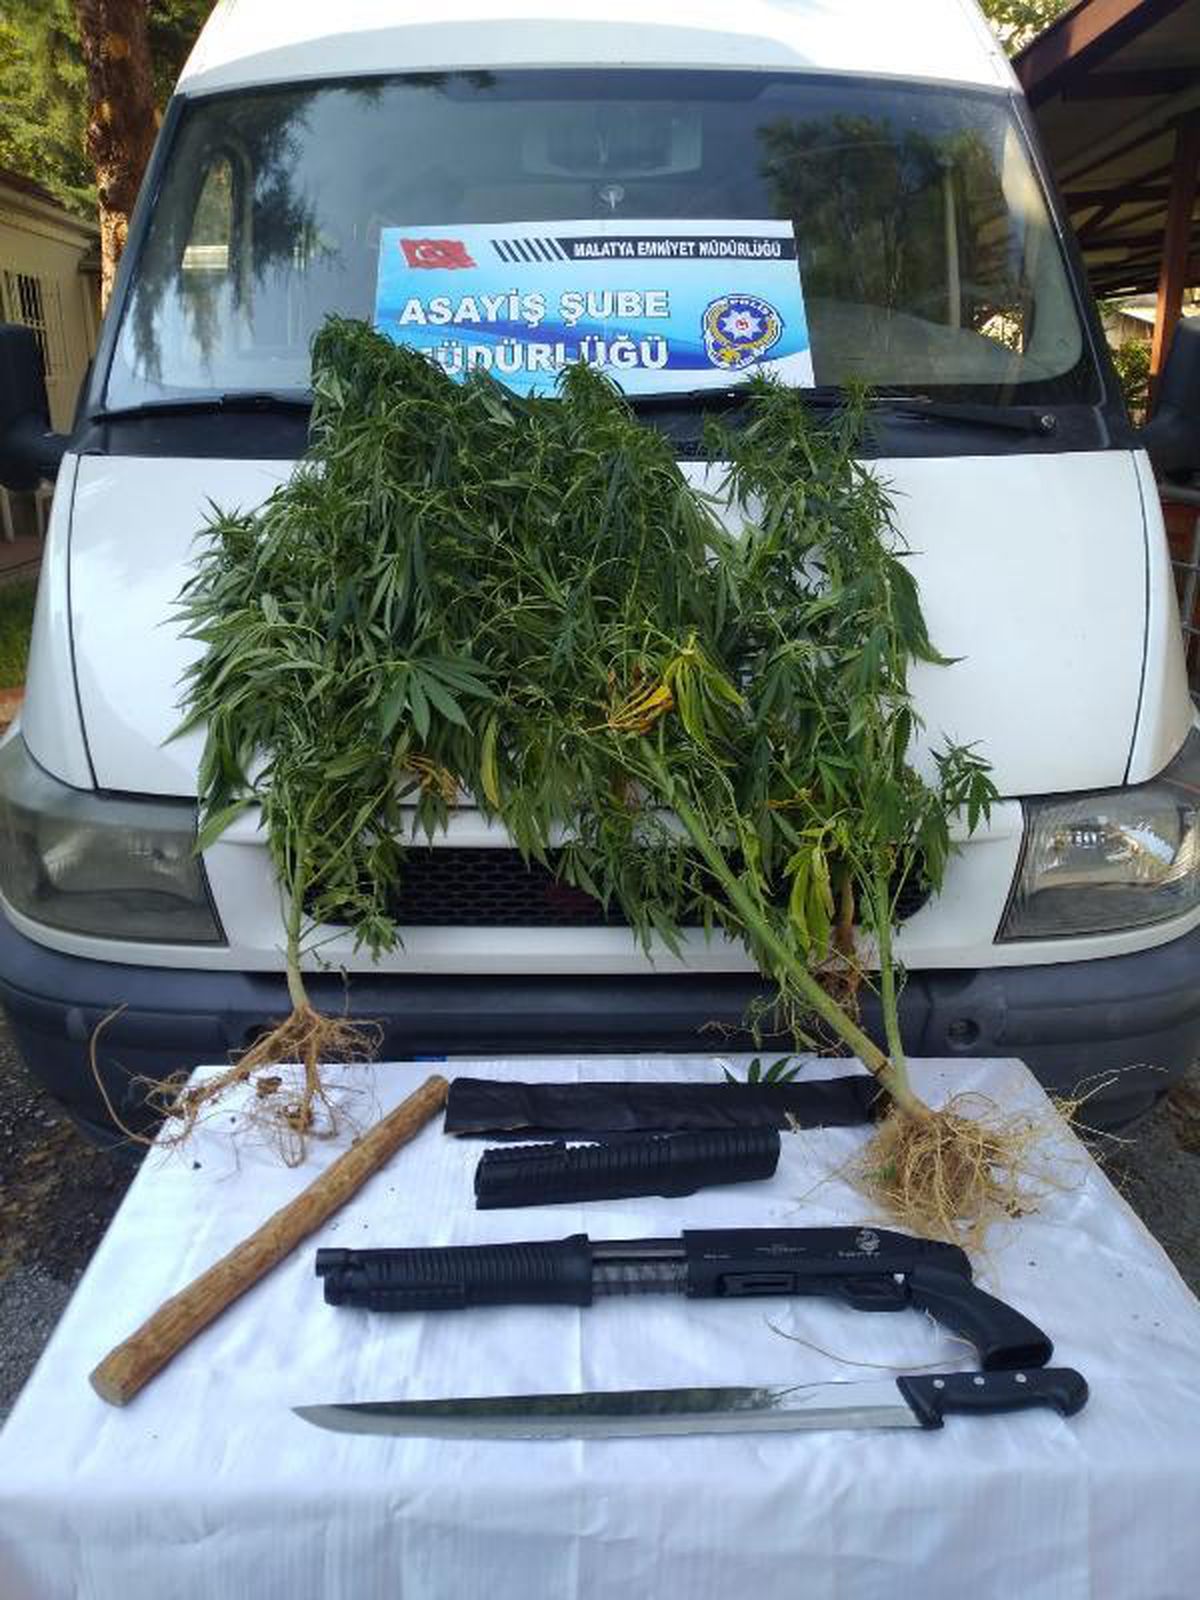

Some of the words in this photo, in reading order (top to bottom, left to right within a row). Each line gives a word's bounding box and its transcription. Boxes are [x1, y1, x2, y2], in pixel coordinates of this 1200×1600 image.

[573, 241, 635, 257] MALATYA
[637, 239, 696, 256] EMNİYET
[699, 239, 782, 257] MÜDÜRLÜĞÜ
[399, 289, 546, 328] ASAYİŞ
[559, 290, 671, 327] ŞUBE
[418, 334, 669, 374] ÜDÜRLÜĞÜ
